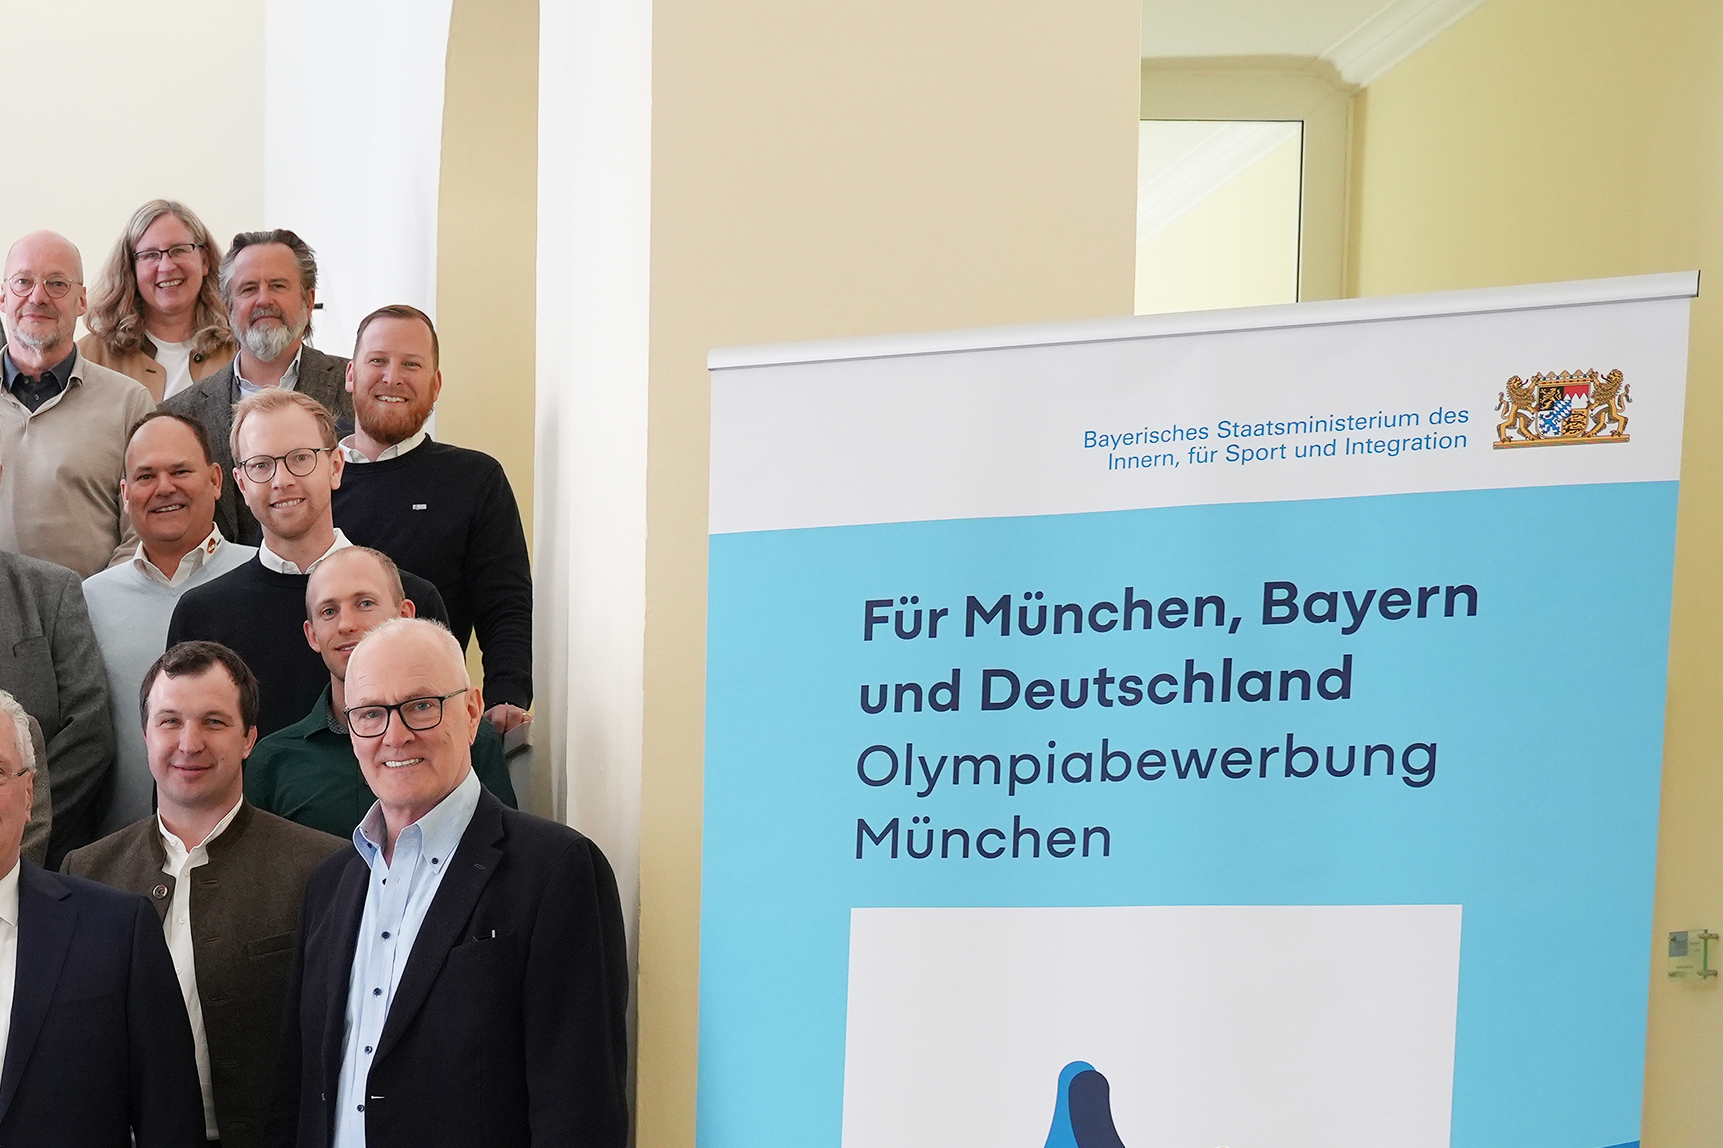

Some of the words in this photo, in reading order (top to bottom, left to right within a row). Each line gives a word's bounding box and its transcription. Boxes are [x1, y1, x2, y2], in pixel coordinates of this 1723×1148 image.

[1083, 425, 1209, 450] Bayerisches
[1217, 412, 1420, 440] Staatsministerium
[1428, 407, 1470, 425] des
[1107, 452, 1180, 471] Innern,
[1187, 446, 1217, 465] für
[1225, 444, 1287, 466] Sport
[1294, 439, 1338, 459] und
[1344, 433, 1468, 457] Integration
[862, 595, 950, 643] Für
[964, 586, 1243, 639] München,
[1261, 581, 1479, 637] Bayern
[859, 667, 962, 716] und
[980, 653, 1354, 712] Deutschland
[856, 732, 1438, 799] Olympiabewerbung
[854, 813, 1112, 861] München
